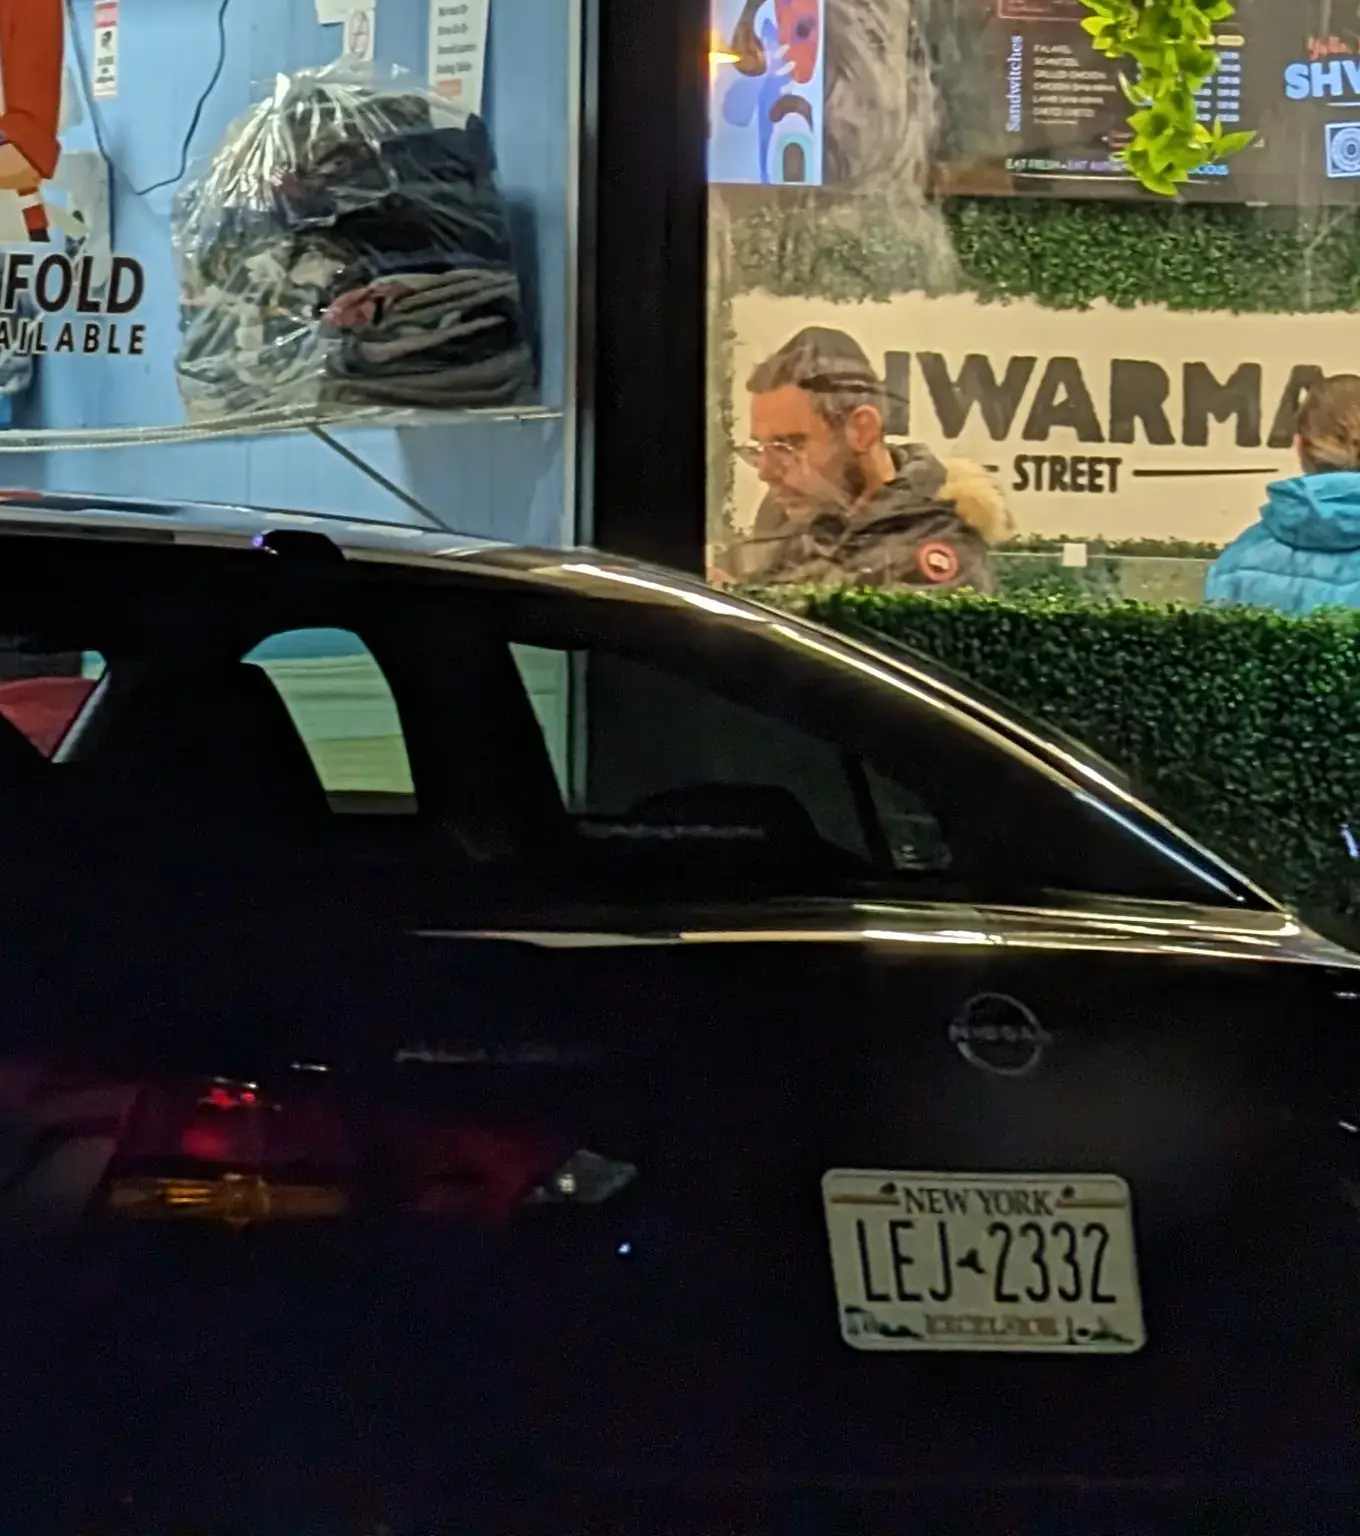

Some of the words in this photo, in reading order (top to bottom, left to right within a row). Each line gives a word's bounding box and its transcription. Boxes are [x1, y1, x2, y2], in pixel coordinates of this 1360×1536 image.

[3, 252, 145, 314] FOLD
[1012, 454, 1123, 493] STREET
[904, 1187, 970, 1215] NEW
[977, 1188, 1054, 1217] YORK
[856, 1220, 953, 1301] LEJ
[988, 1222, 1117, 1303] 2332
